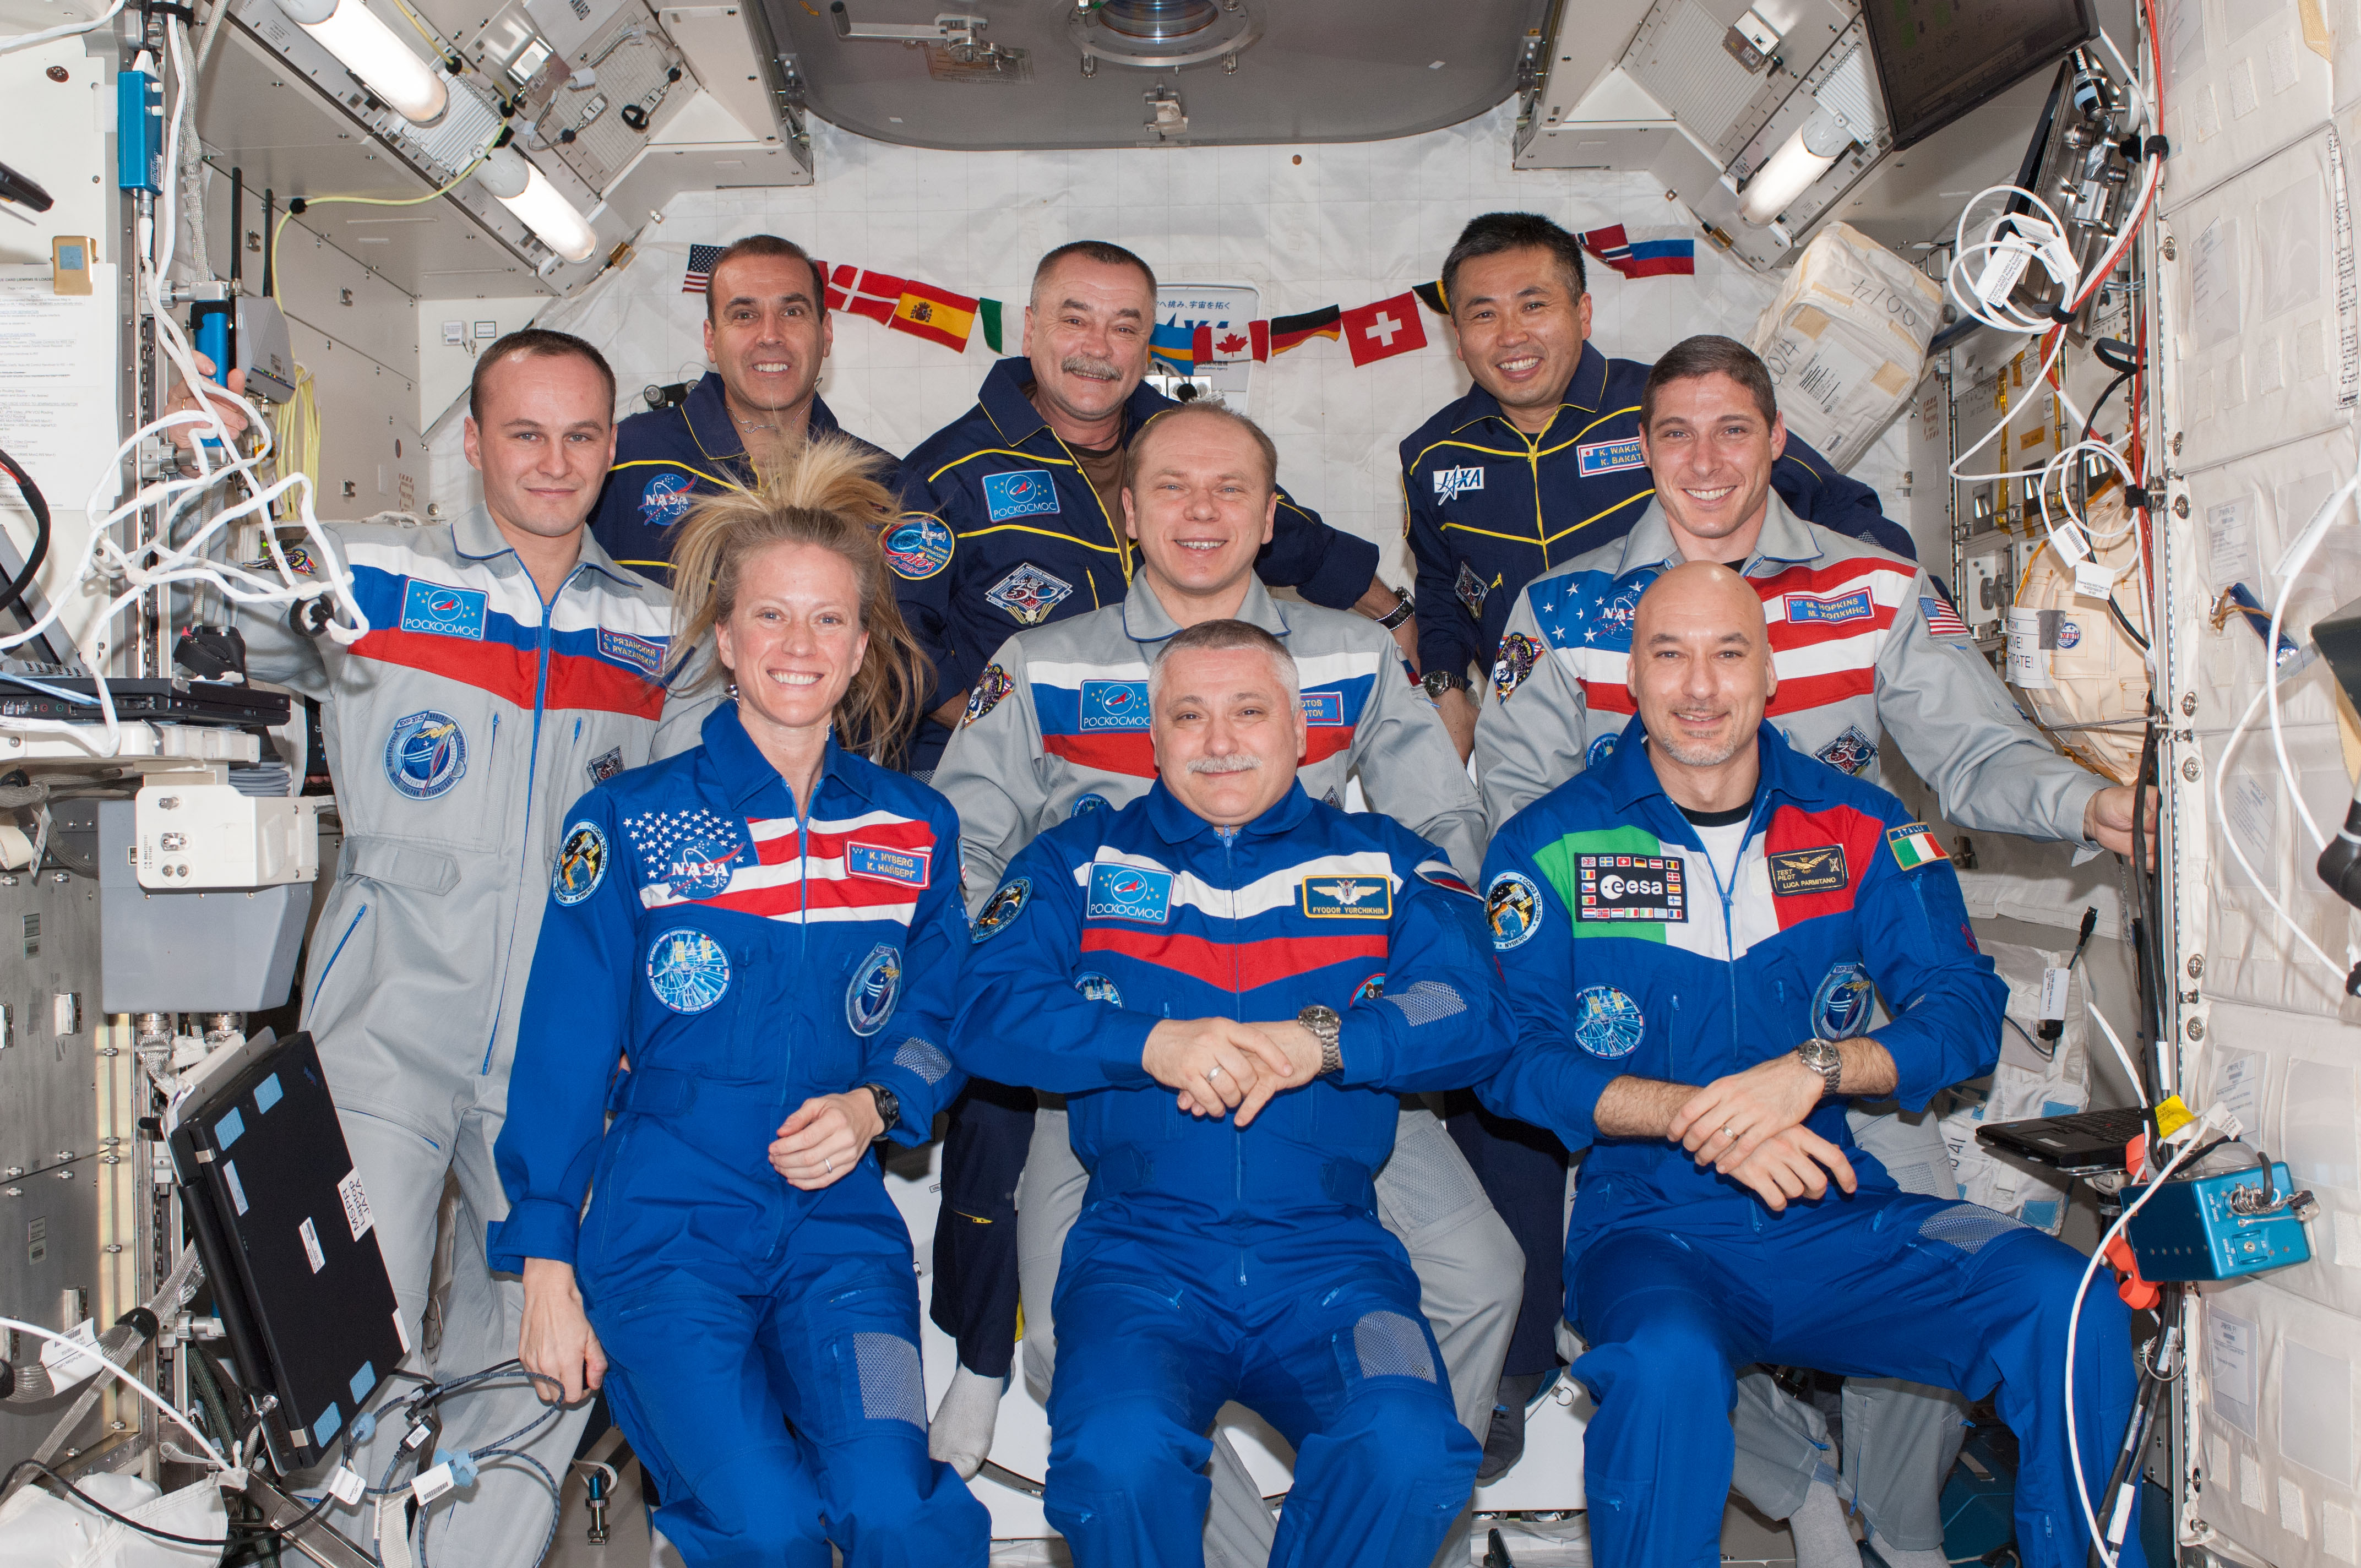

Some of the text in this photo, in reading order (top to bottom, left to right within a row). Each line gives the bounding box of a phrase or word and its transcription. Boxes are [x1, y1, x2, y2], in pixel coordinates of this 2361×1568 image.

[1599, 444, 1640, 457] K. WAKAT
[1612, 453, 1641, 464] ВАКАТ
[1436, 467, 1481, 503] JAXA
[646, 494, 688, 507] NASA
[994, 502, 1056, 518] РОСКОСМОС
[1819, 598, 1859, 612] HOPKINS
[1821, 607, 1866, 619] ХОПКИНС
[1602, 607, 1635, 620] NAS
[405, 618, 480, 637] РОСКОСМОС
[613, 637, 656, 658] РЯЗАНСКИЙ
[613, 645, 657, 667] RYAZANSKIY
[1300, 699, 1322, 707] ОТОВ
[869, 852, 913, 868] K. NYBERG
[672, 862, 730, 877] NASA
[867, 862, 916, 879] К. НАЙБЕРГ
[1522, 878, 1537, 894] СОЮЗ
[1800, 876, 1836, 886] PARMITANO
[1090, 903, 1163, 920] РОСКОСМОС
[1505, 934, 1527, 948] NYBERG
[349, 1180, 365, 1226] Laptop
[355, 1177, 370, 1214] JAXA
[342, 1188, 360, 1232] MSPR
